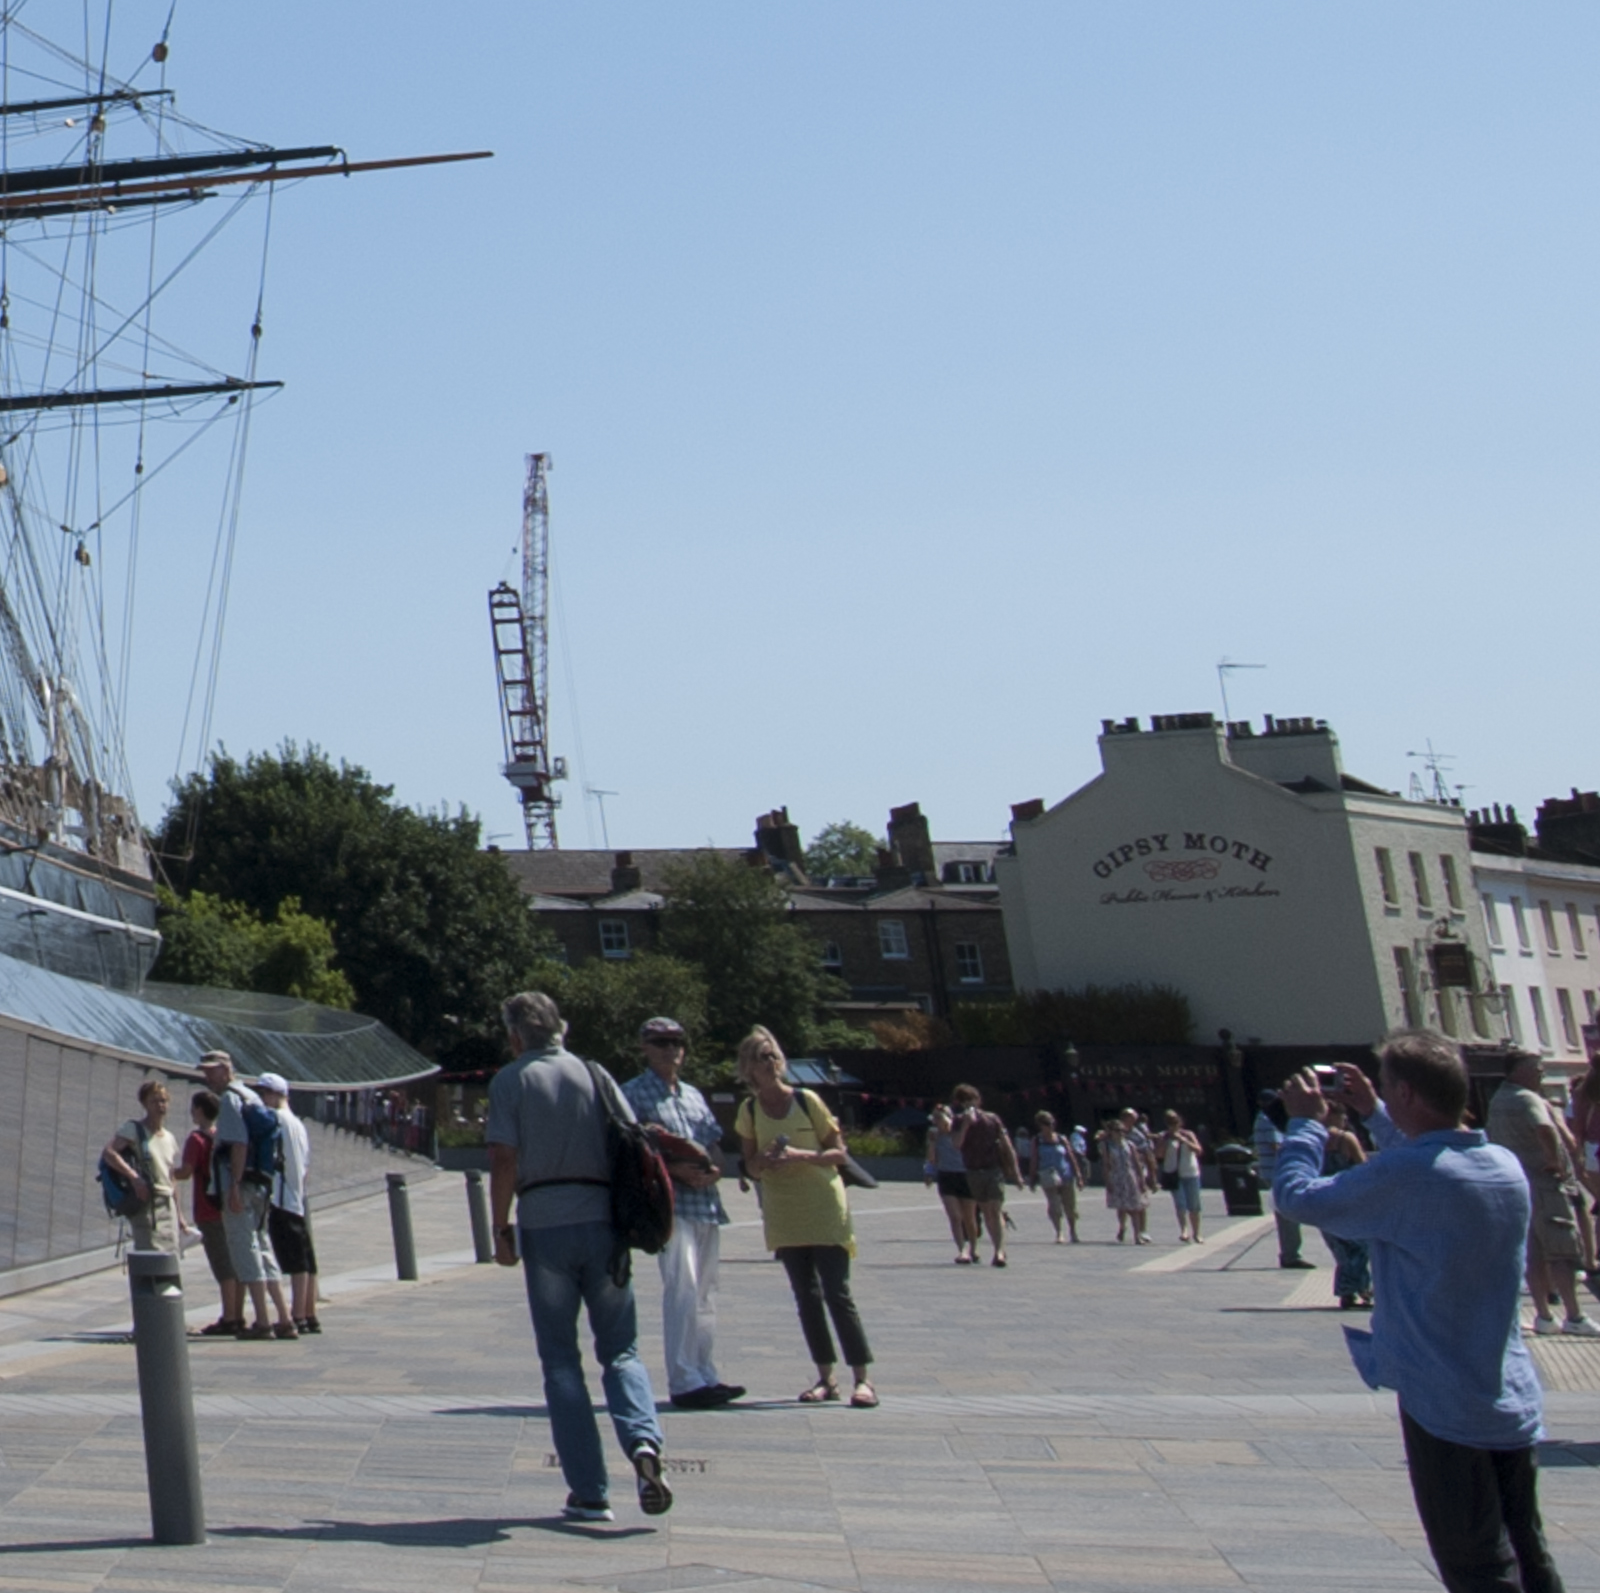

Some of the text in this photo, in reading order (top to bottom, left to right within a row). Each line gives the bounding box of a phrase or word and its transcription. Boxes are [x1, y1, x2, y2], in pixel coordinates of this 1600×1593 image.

[1092, 832, 1273, 879] GIPSY MOTH
[1079, 1064, 1219, 1077] GIPSY MOTH
